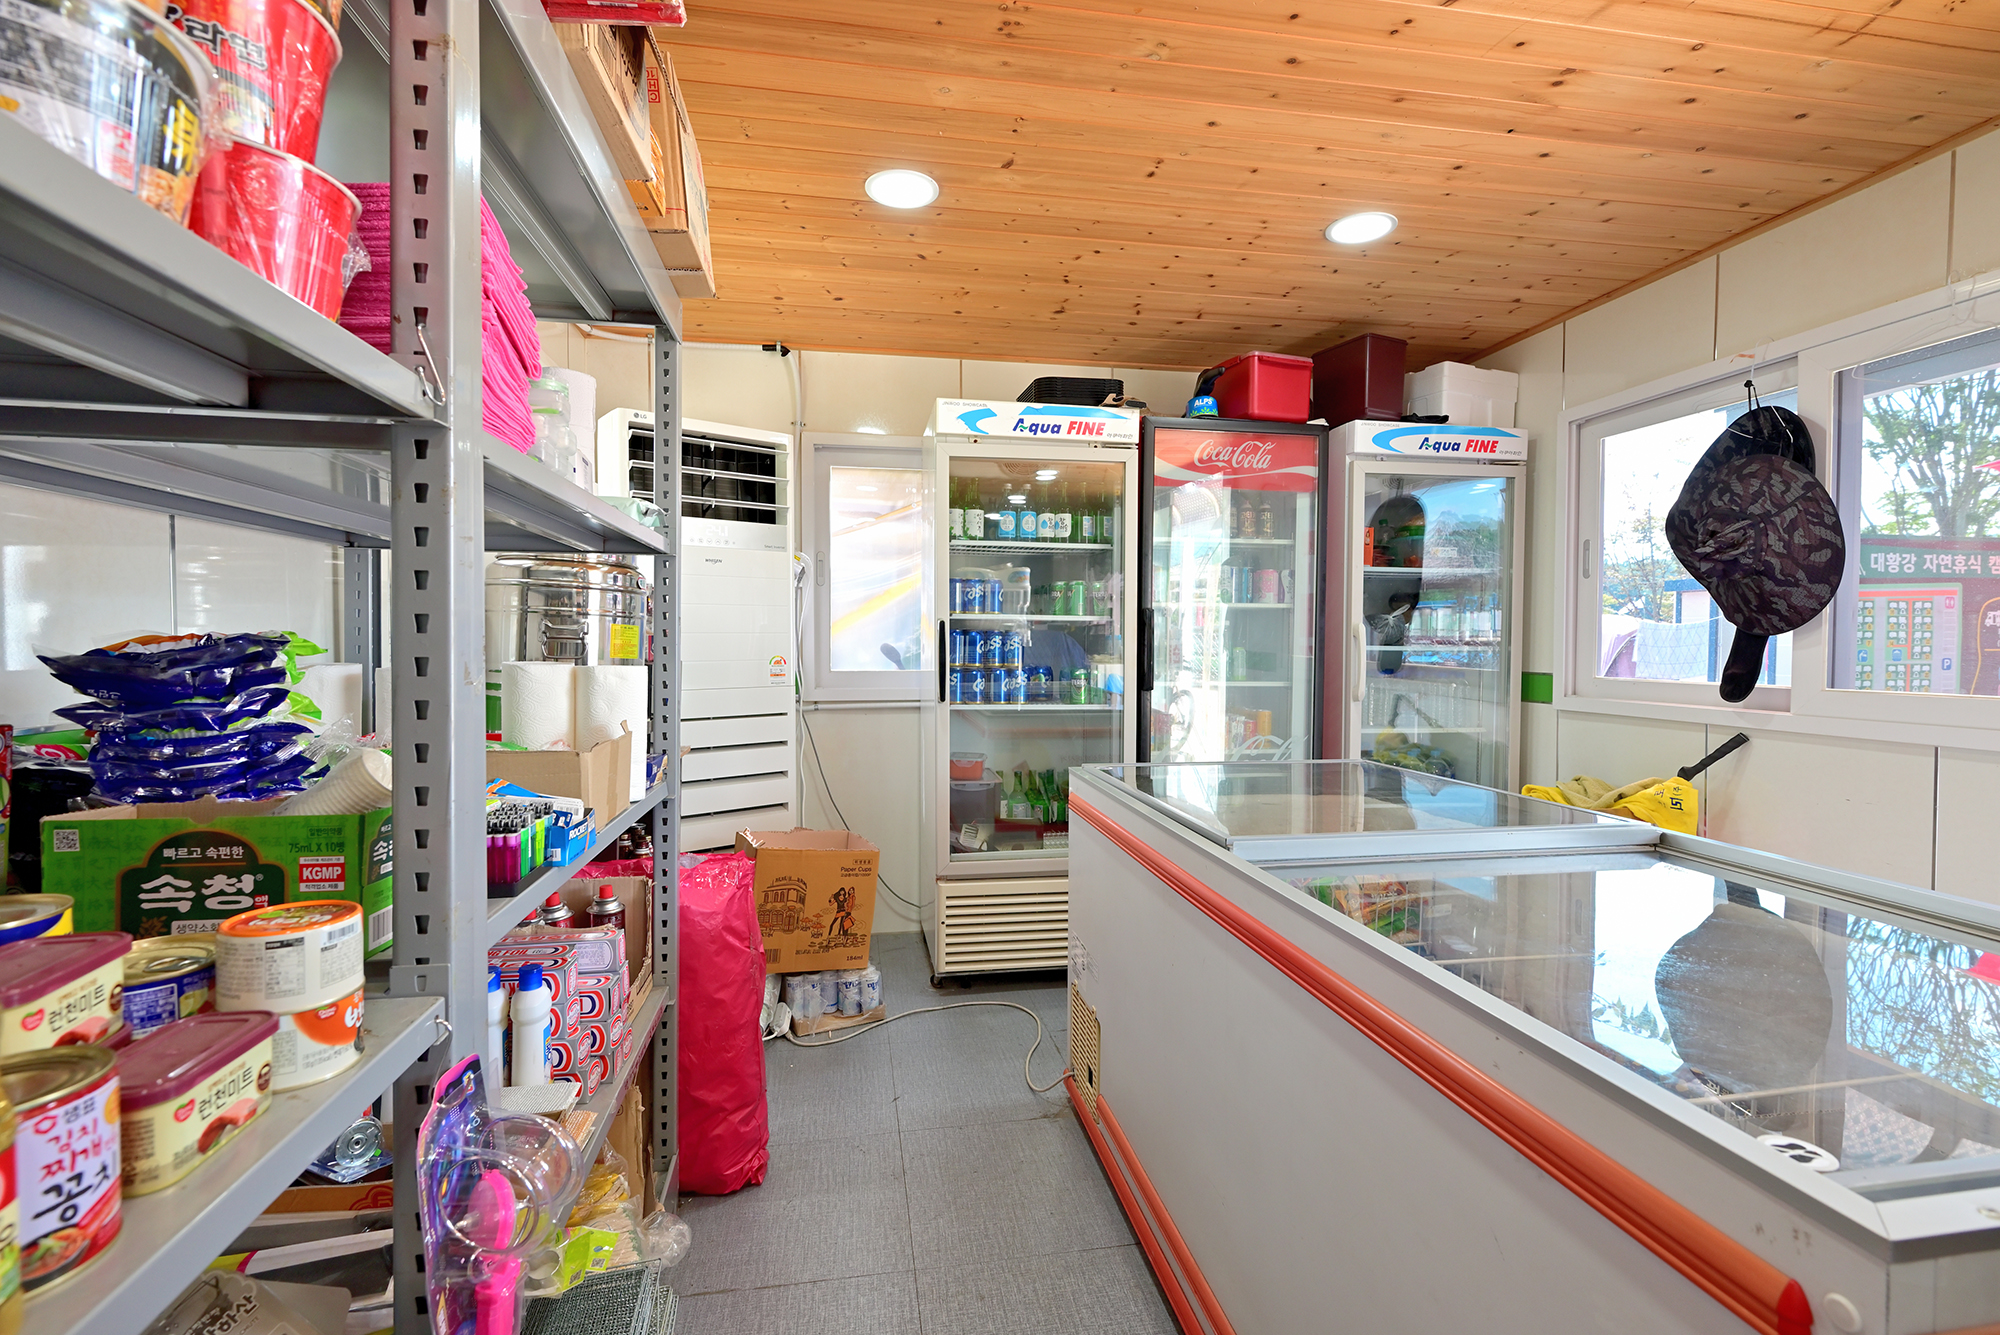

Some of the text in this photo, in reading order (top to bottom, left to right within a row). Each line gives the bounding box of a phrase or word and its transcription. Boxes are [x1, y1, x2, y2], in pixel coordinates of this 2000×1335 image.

[1193, 398, 1213, 407] ALPS
[1012, 418, 1106, 436] Aqua FINE
[1193, 439, 1277, 469] Coca-Cola
[1418, 436, 1499, 454] Aqua FINE
[1870, 553, 1917, 573] 대황강
[1923, 554, 1982, 574] 자연휴식
[162, 846, 245, 860] 빠르고 속편한
[288, 841, 345, 853] 75mL X 10병
[373, 840, 393, 861] 속
[302, 866, 342, 880] KGMP
[138, 874, 255, 913] 속청
[48, 984, 106, 1032] 런천미트
[198, 1066, 254, 1120] 런천미트
[61, 1097, 96, 1124] 샘표
[46, 1117, 98, 1153] 김치
[31, 1161, 111, 1223] 꽁치
